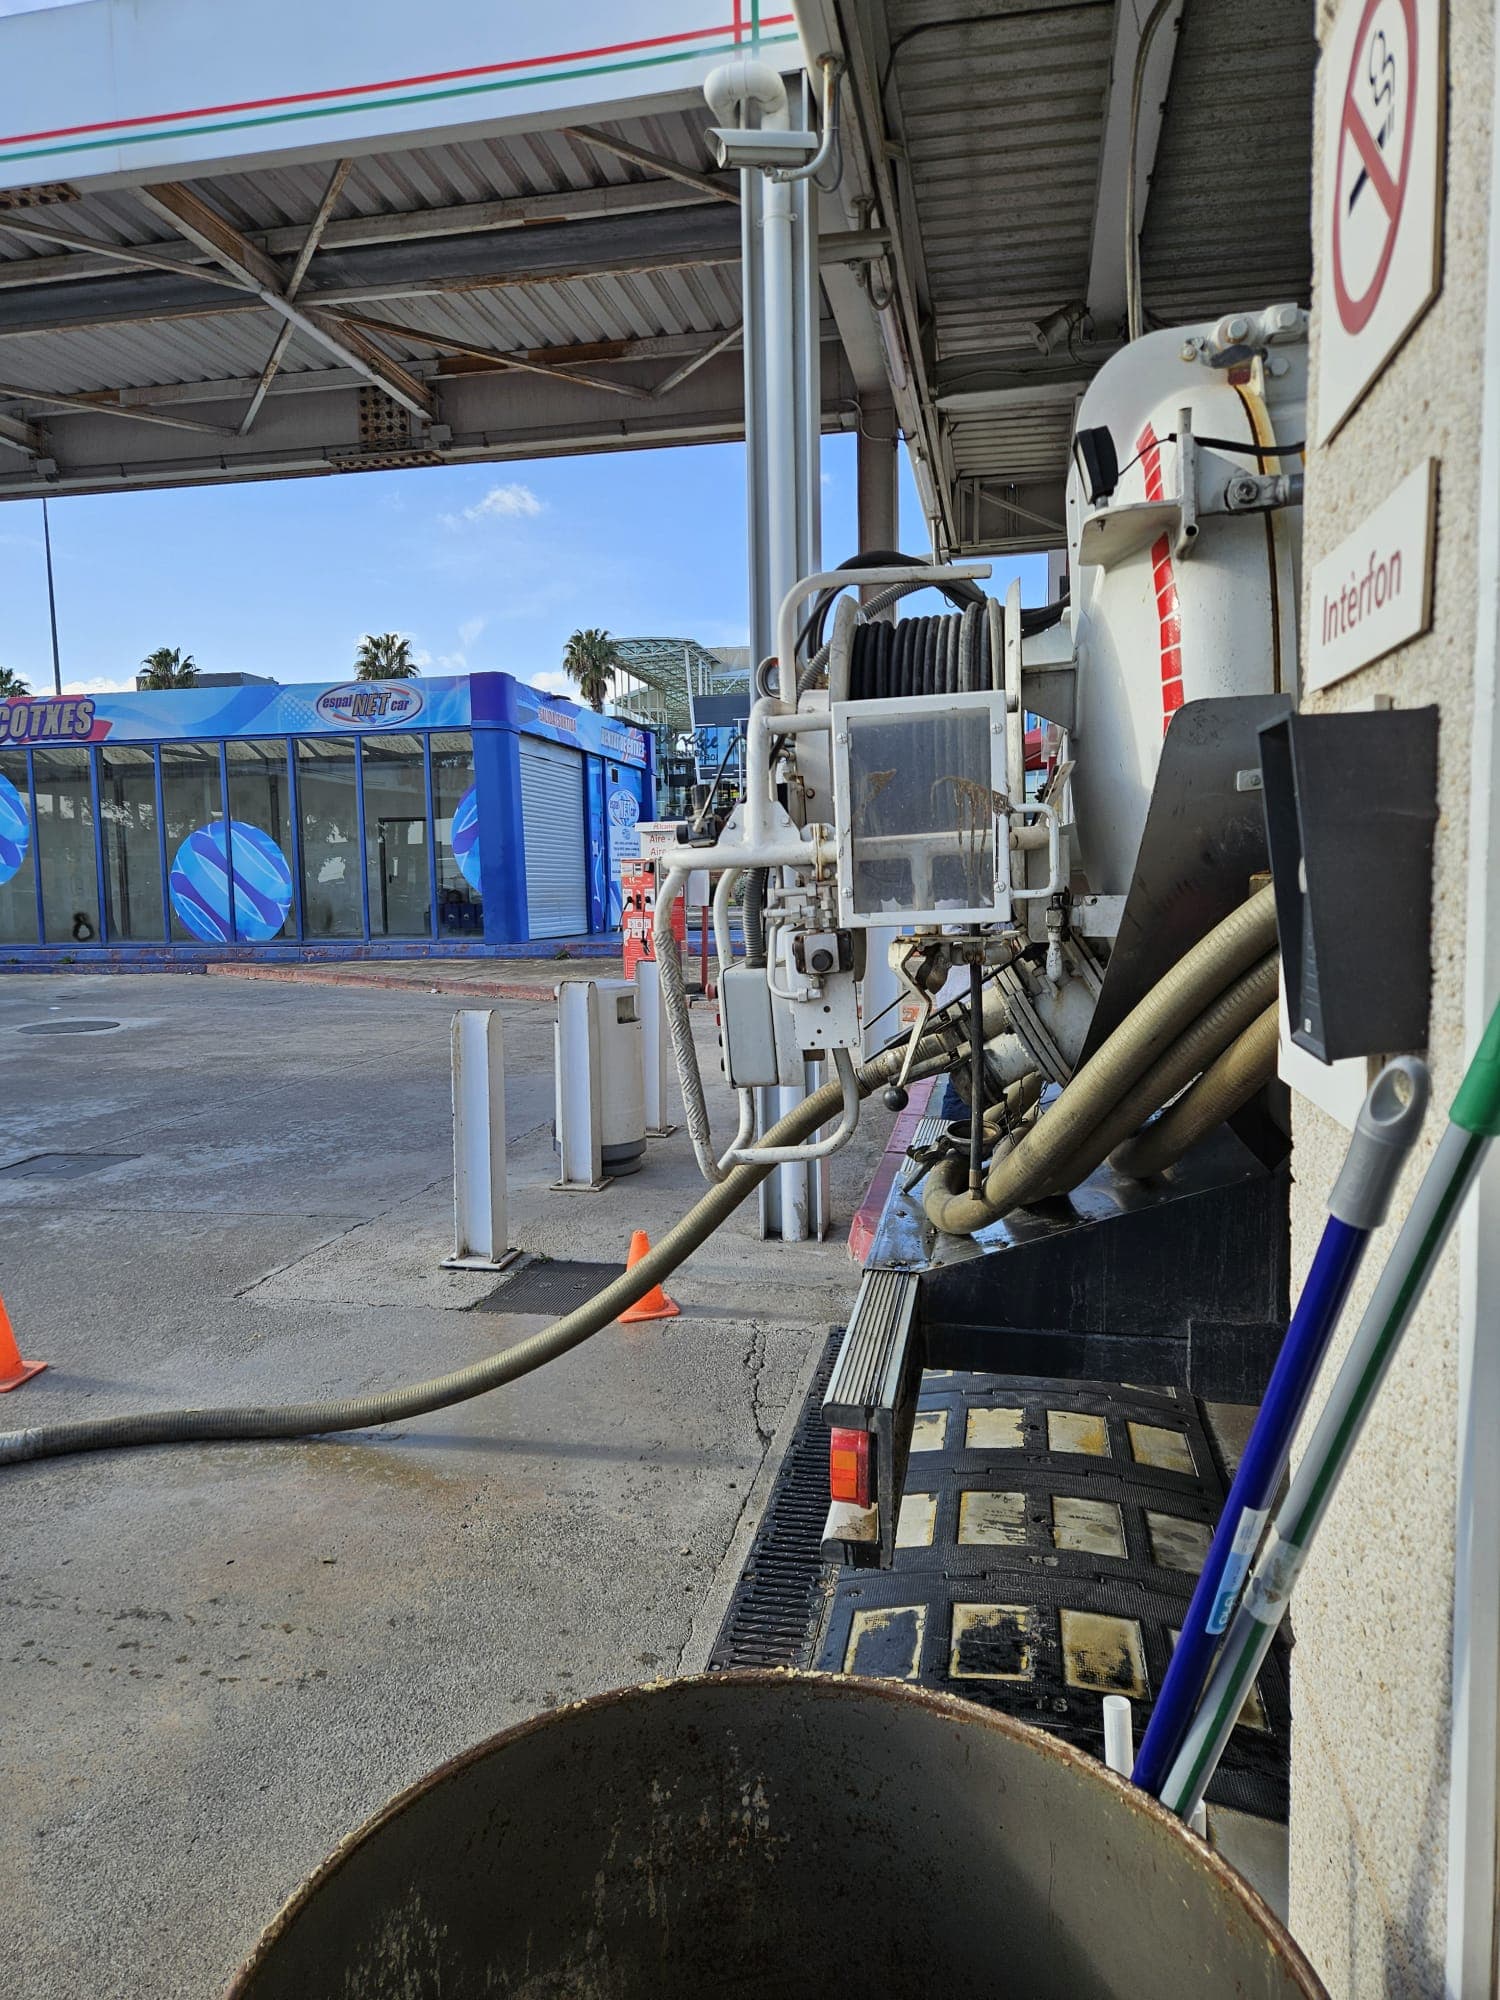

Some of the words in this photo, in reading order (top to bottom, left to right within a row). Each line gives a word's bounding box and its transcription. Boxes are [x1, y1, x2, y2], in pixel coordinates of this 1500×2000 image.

[1322, 549, 1402, 646] Intèrfon
[322, 695, 352, 709] espai
[352, 692, 391, 716] NET
[390, 699, 410, 712] car
[0, 701, 94, 738] COTXES
[650, 834, 666, 843] Aire
